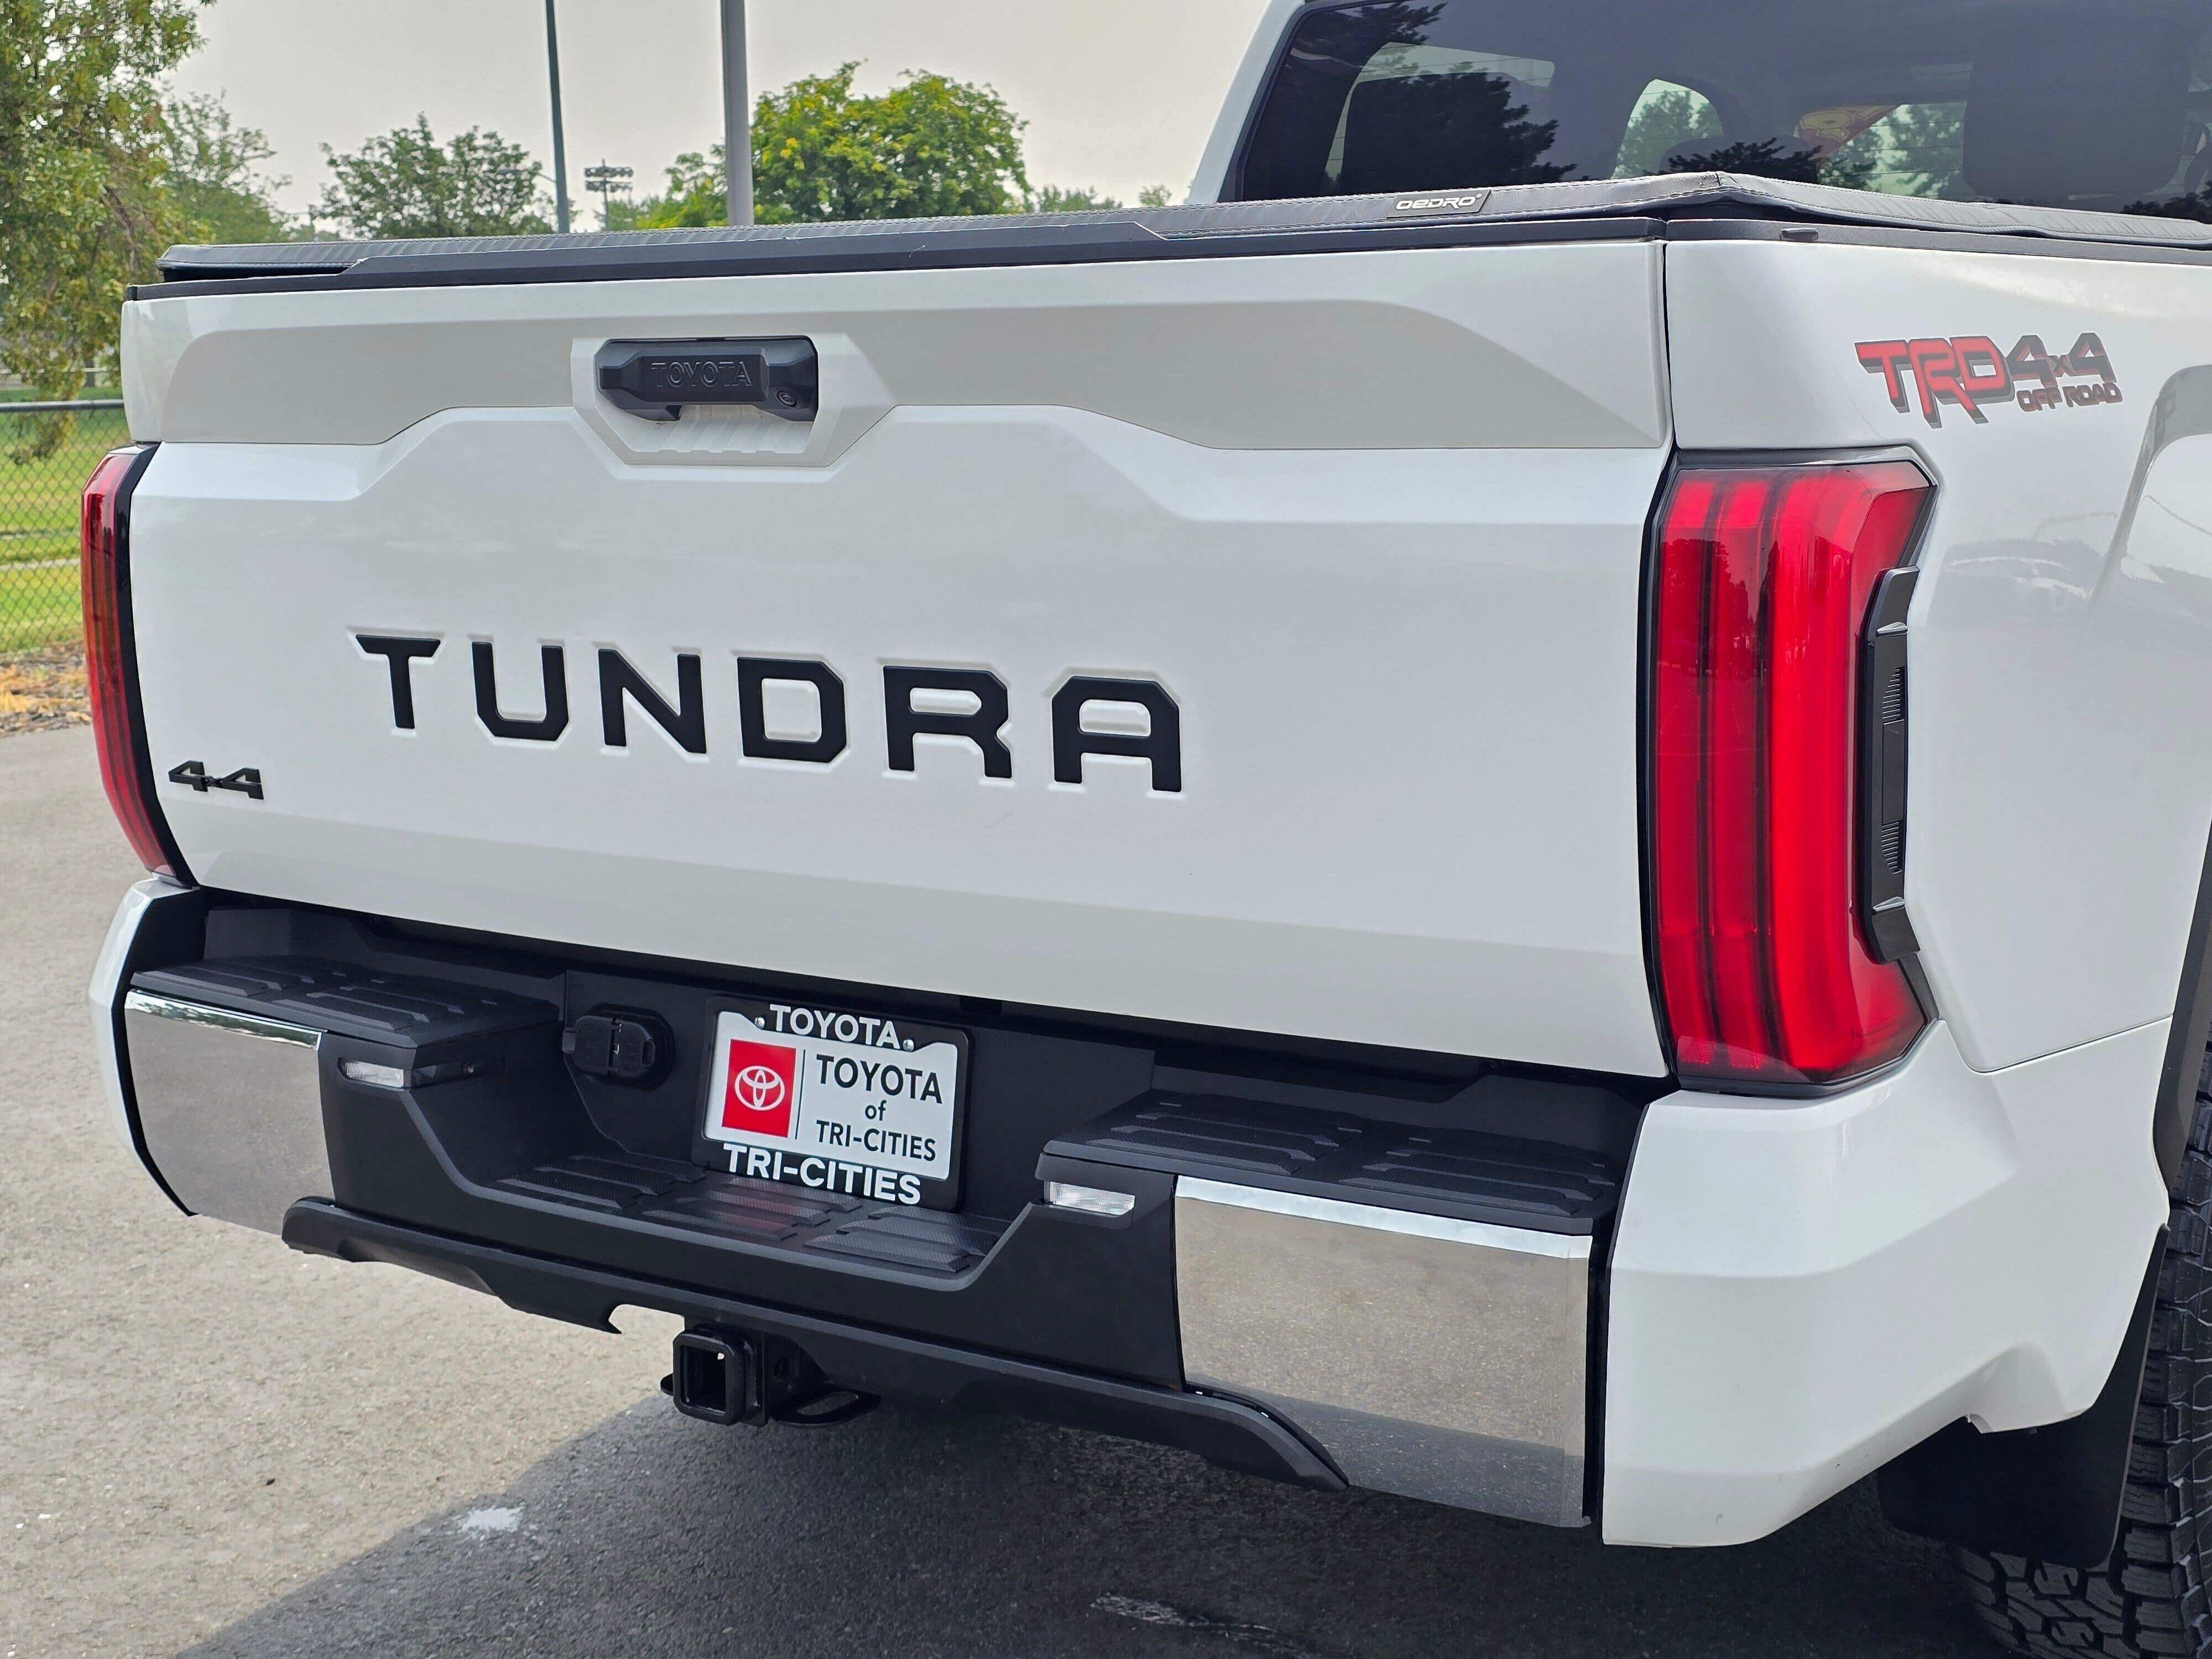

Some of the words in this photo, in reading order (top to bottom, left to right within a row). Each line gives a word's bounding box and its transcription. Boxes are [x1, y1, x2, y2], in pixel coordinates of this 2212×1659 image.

[651, 361, 753, 388] TOYOTA
[1854, 335, 2015, 429] TRD
[2016, 388, 2063, 412] OFF
[2063, 383, 2123, 408] ROAD
[354, 634, 1182, 792] TUNDRA
[770, 1004, 900, 1050] TOYOTA
[816, 1054, 943, 1104] TOYOTA
[864, 1100, 886, 1121] of
[816, 1119, 936, 1162] TRI-CITIES
[723, 1143, 921, 1205] TRI-CITIES
